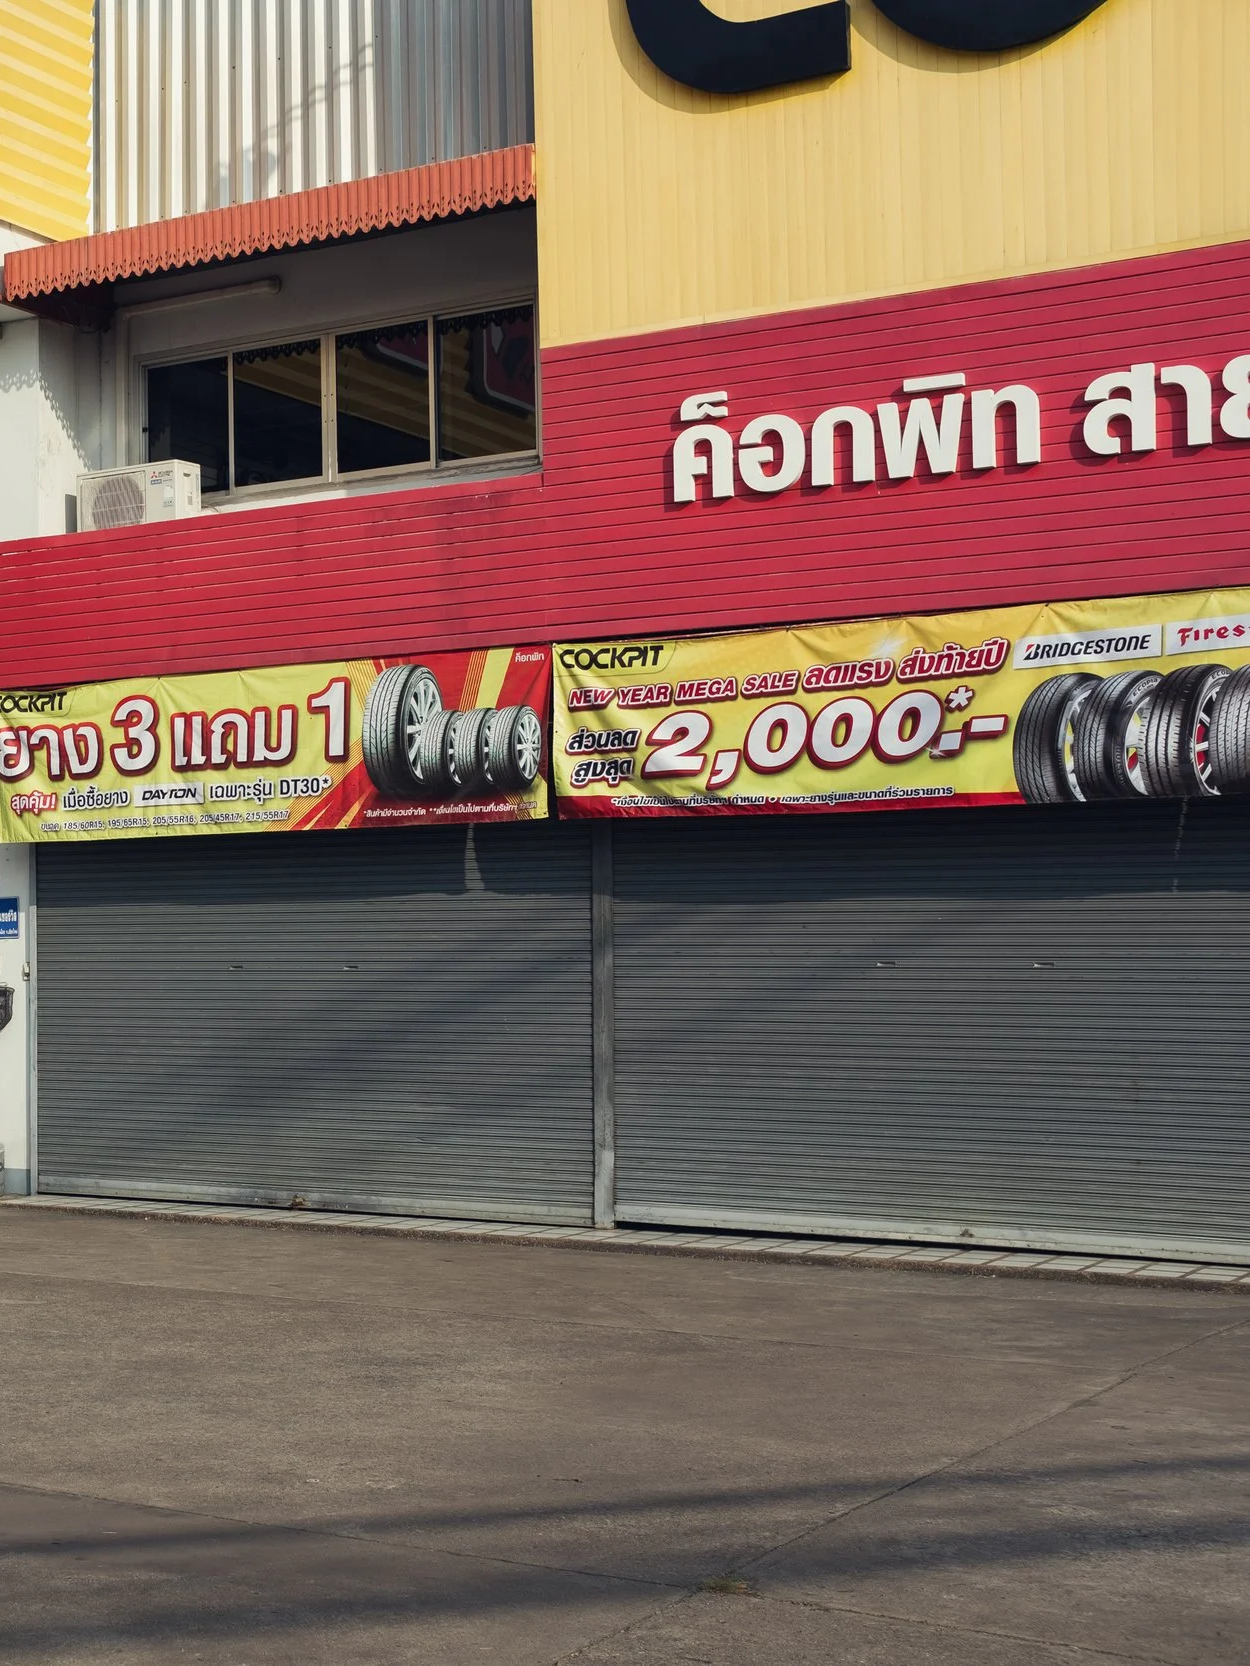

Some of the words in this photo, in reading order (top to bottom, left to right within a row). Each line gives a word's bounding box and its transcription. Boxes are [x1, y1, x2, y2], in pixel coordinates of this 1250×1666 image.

[672, 373, 1041, 502] ค็อกพิท
[560, 645, 663, 670] COCKPIT
[1023, 634, 1151, 661] BRIDGESTONE
[1177, 624, 1250, 647] Fires
[570, 688, 614, 708] NEW
[618, 685, 670, 706] YEAR
[676, 678, 736, 701] MEGA
[741, 671, 798, 695] SALE
[803, 659, 892, 688] ลดแรง
[898, 638, 1008, 679] ส่งท้ายปี
[112, 697, 158, 773] 3
[172, 706, 296, 768] แถม
[309, 679, 348, 759] 1
[567, 727, 639, 752] ส่วนลด
[573, 759, 633, 785] สูงสุด
[11, 790, 56, 815] สุดคุ้ม!
[63, 786, 128, 809] เมื่อซื้อยาง
[142, 787, 197, 801] DAYTON
[209, 779, 272, 803] เฉพาะรุ่น
